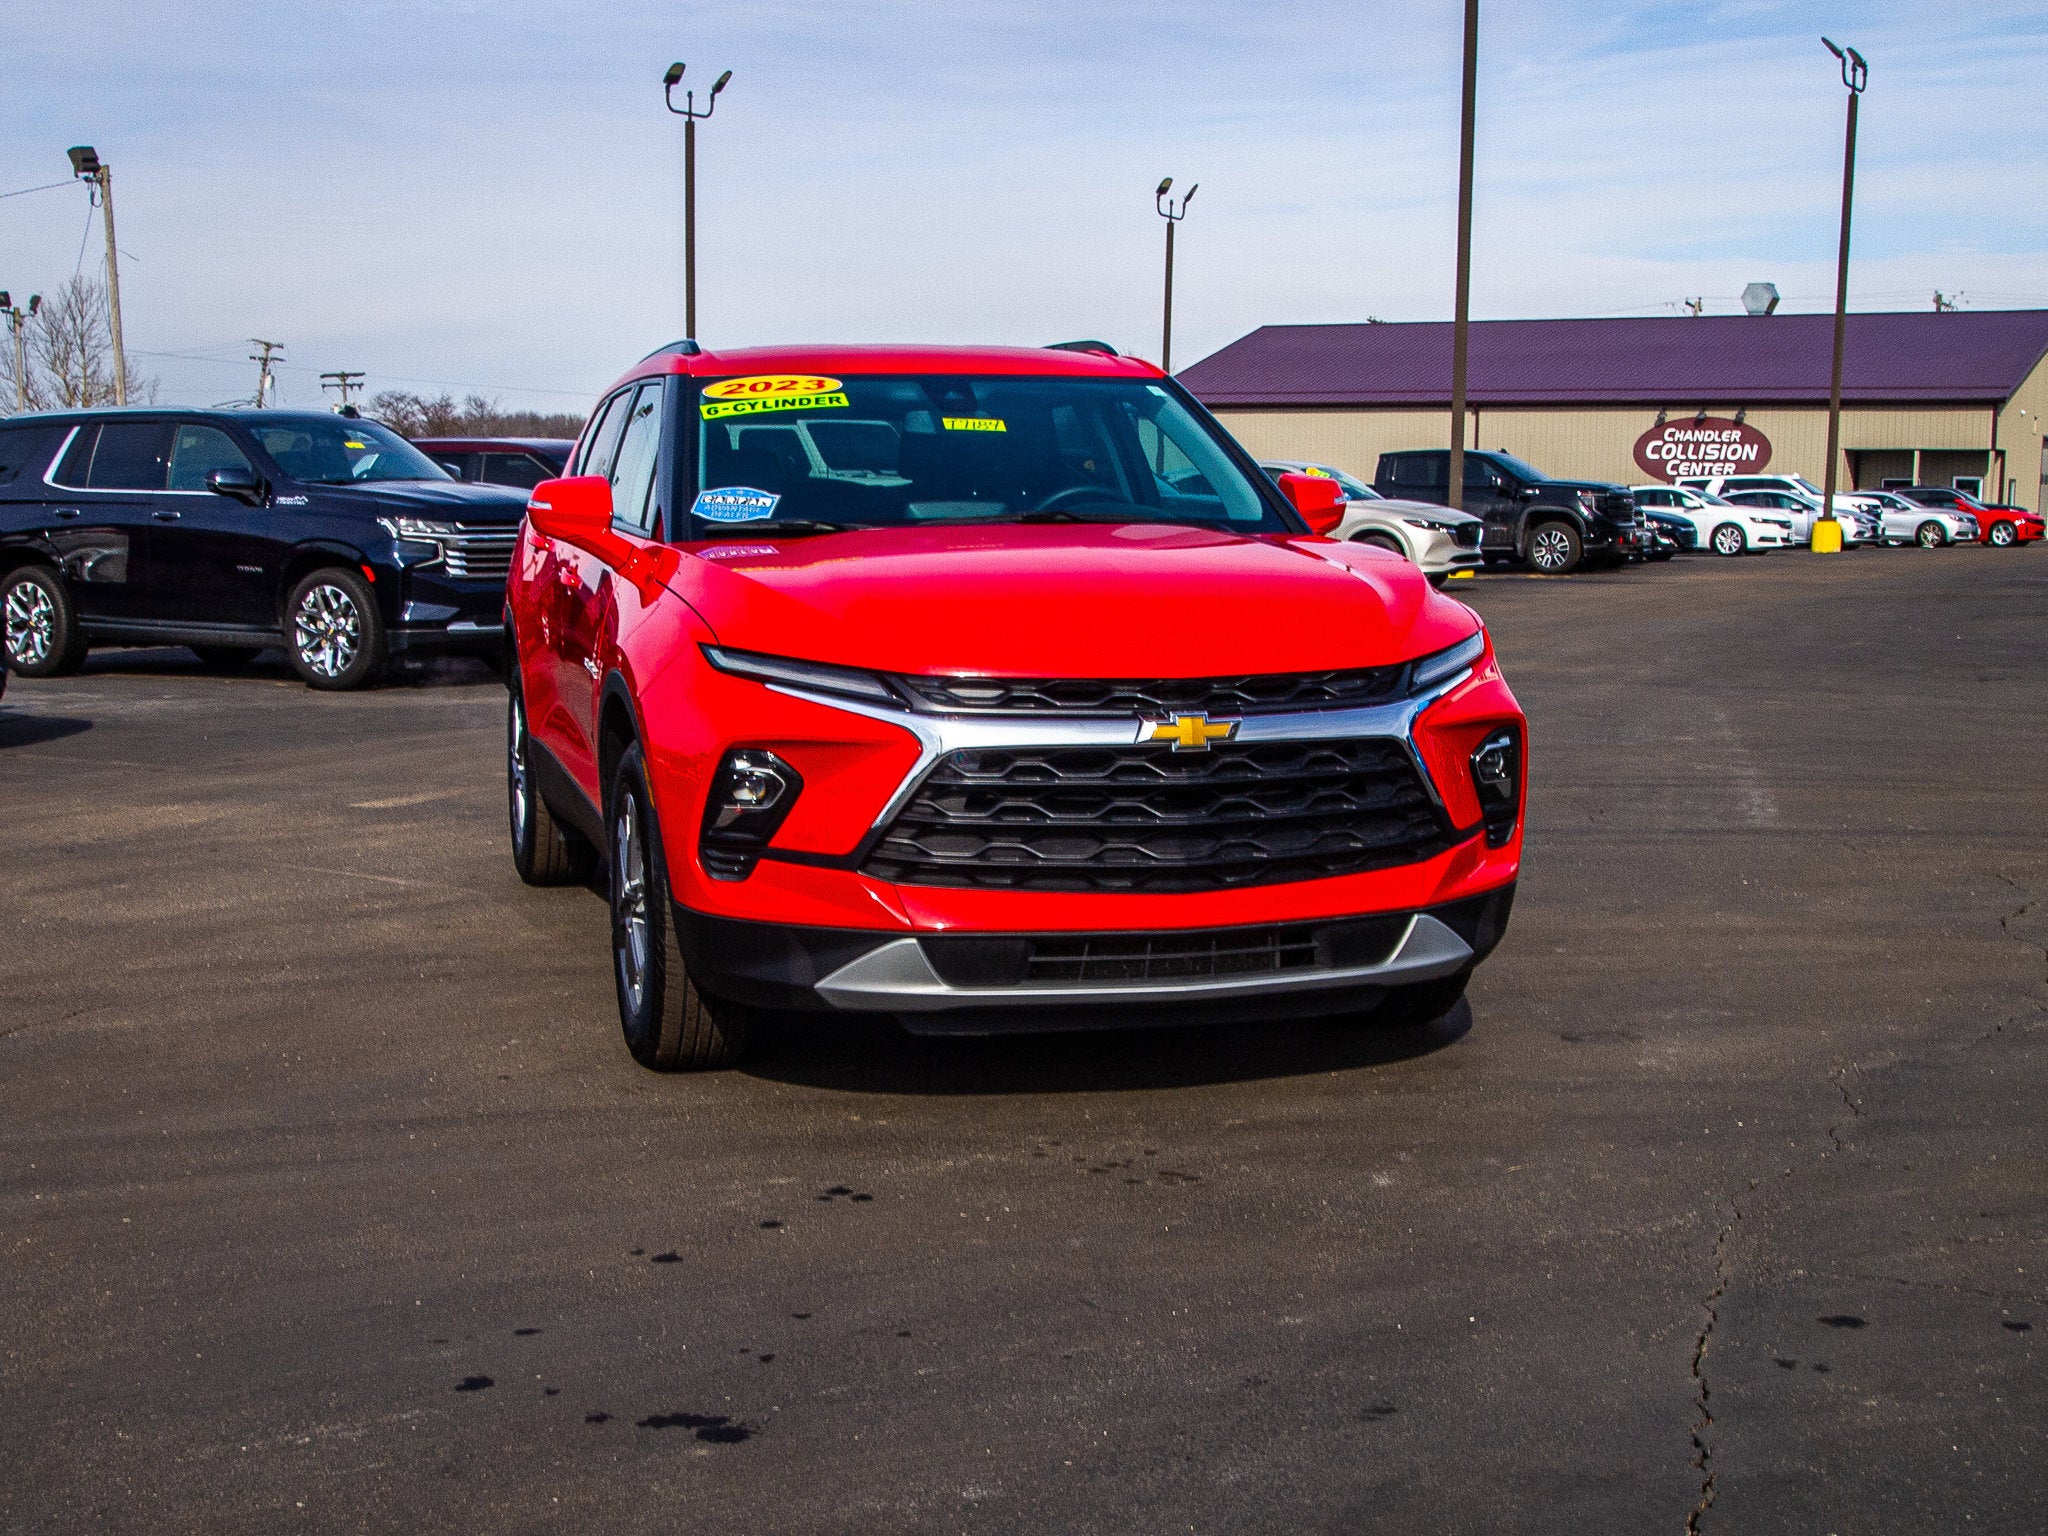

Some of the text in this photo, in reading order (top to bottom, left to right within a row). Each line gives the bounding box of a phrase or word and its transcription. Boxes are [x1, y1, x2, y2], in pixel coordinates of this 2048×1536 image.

[721, 380, 826, 396] 2023
[706, 396, 843, 416] 6-CYLINDER
[1663, 427, 1742, 443] CHANDLER
[1645, 440, 1759, 461] COLLISION
[1665, 459, 1737, 476] CENTER
